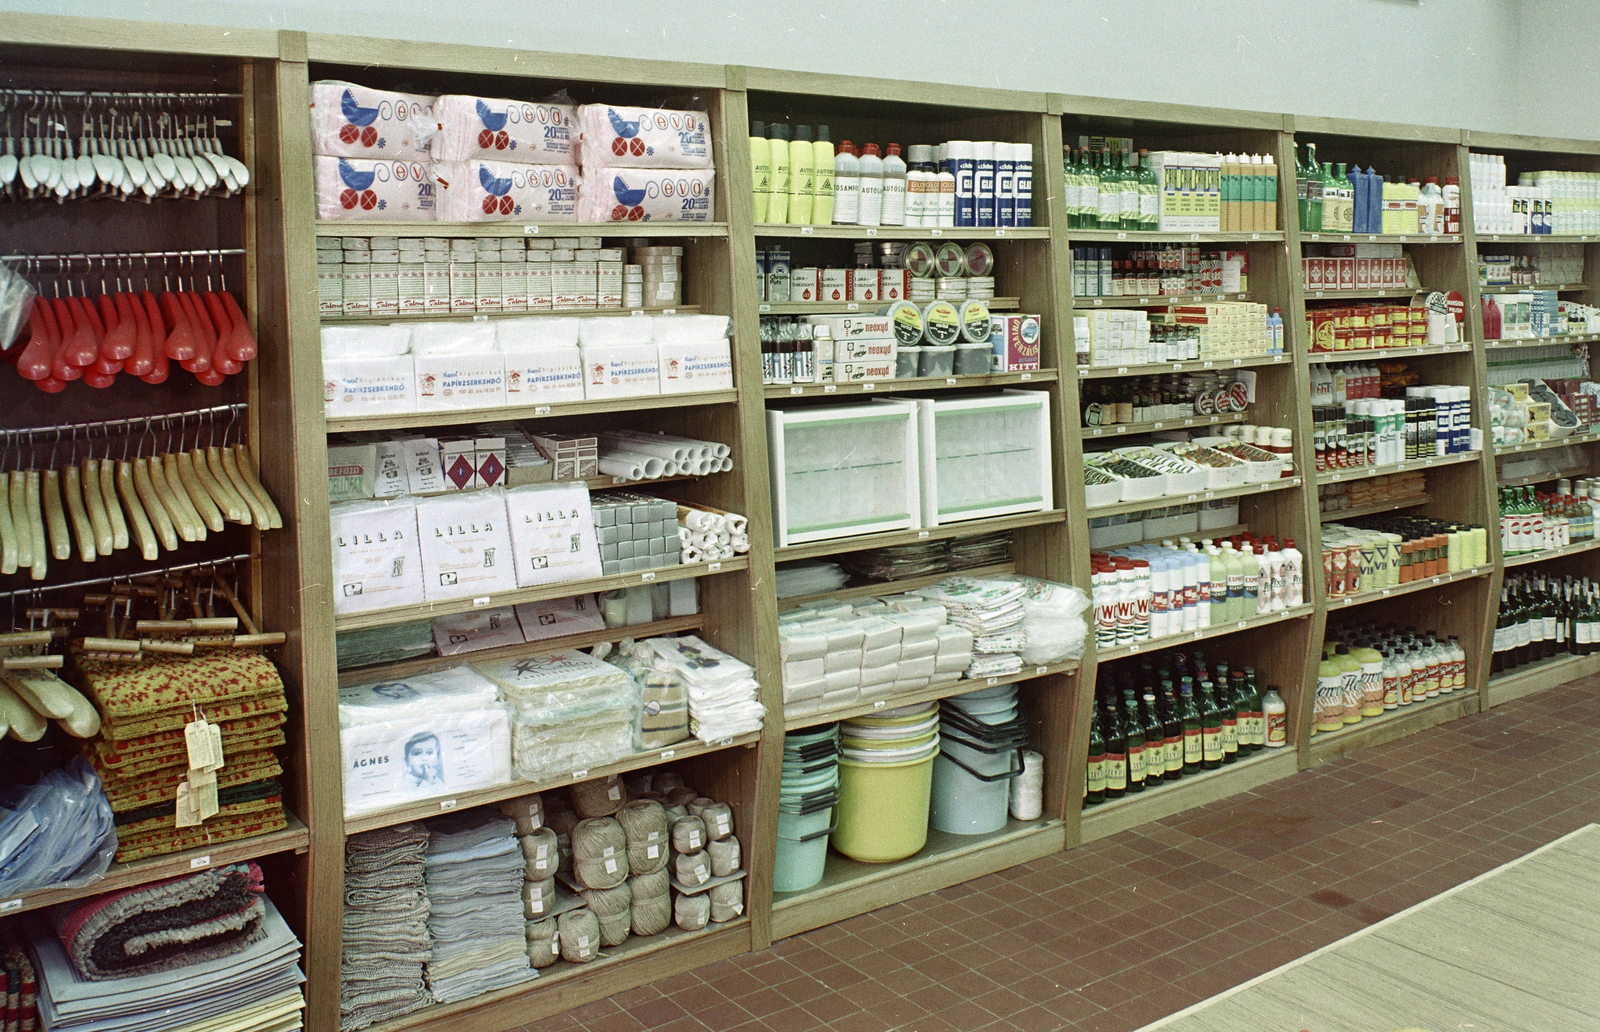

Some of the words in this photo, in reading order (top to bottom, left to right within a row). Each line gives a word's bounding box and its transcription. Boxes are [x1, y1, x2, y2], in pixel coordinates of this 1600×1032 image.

[544, 126, 556, 139] 20
[418, 183, 431, 197] 20
[548, 189, 562, 201] 20
[681, 198, 695, 210] 20
[864, 321, 889, 334] neoxyd
[867, 343, 892, 355] neoxyd
[866, 365, 890, 377] neoxyd
[1008, 363, 1038, 371] KITT
[524, 508, 579, 524] LILLA
[434, 521, 493, 538] LILLA
[338, 529, 404, 547] LILLA
[1137, 599, 1150, 613] W
[352, 755, 390, 769] ÁGNES
